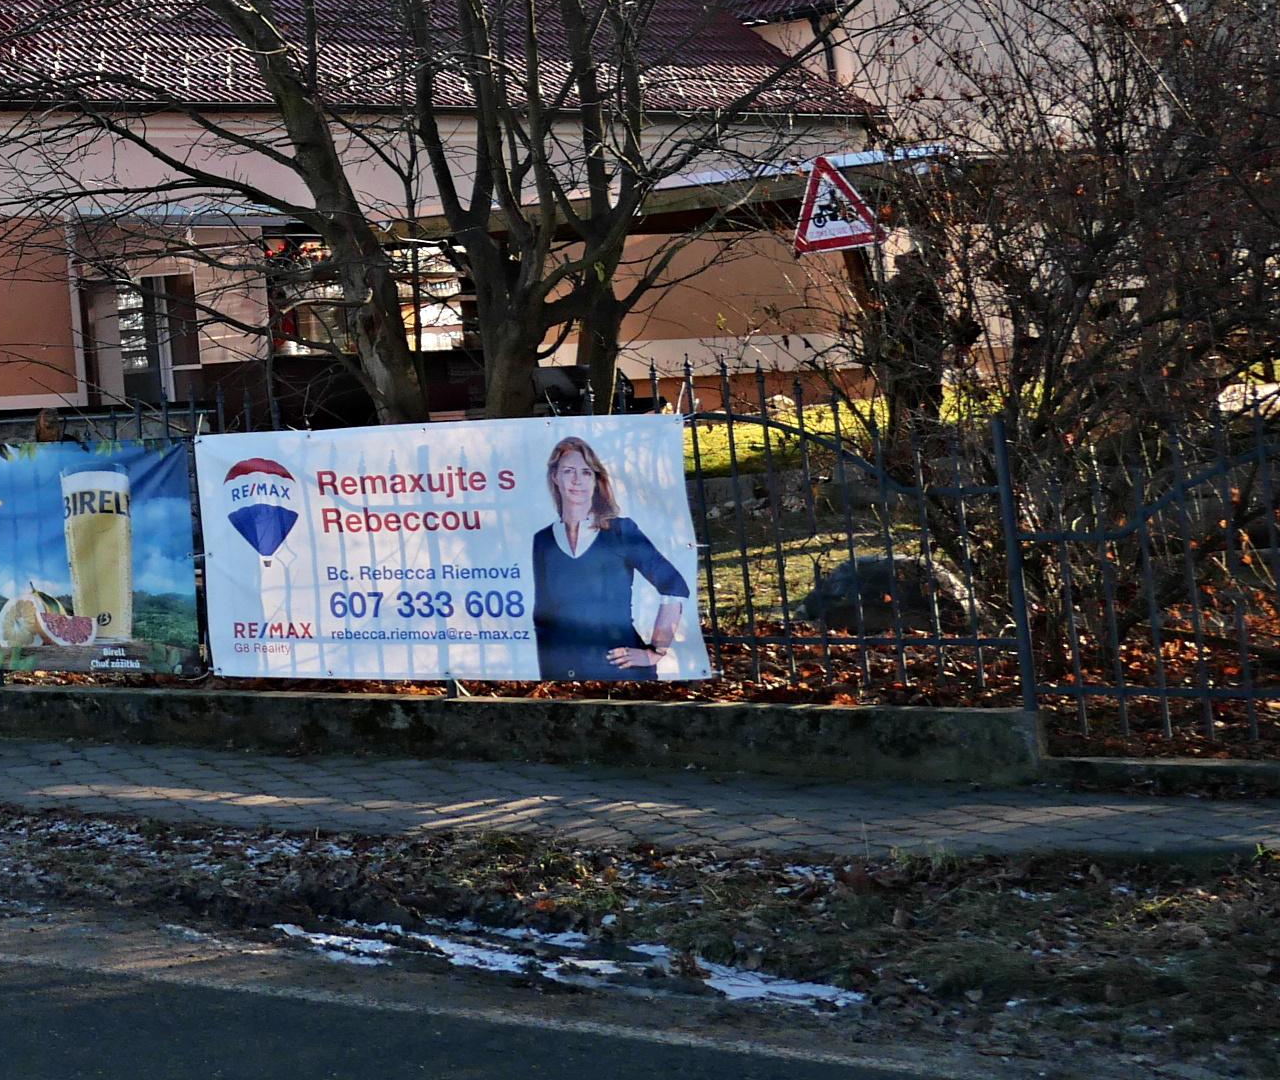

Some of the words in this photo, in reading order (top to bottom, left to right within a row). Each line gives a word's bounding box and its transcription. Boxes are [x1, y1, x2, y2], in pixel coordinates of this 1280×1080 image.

[316, 465, 487, 498] Remaxujte
[497, 470, 516, 491] s
[231, 482, 291, 502] RE/MAX
[321, 507, 481, 534] Rebeccou
[326, 566, 355, 581] Bc.
[359, 565, 436, 580] Rebecca
[442, 563, 521, 580] Riemová
[329, 591, 384, 619] 607
[396, 590, 455, 619] 333
[464, 590, 525, 618] 608
[234, 622, 314, 639] RE/MAX
[331, 627, 530, 641] rebecca.riemova@re-max.cz
[102, 648, 126, 657] Birell
[253, 642, 291, 656] Reality
